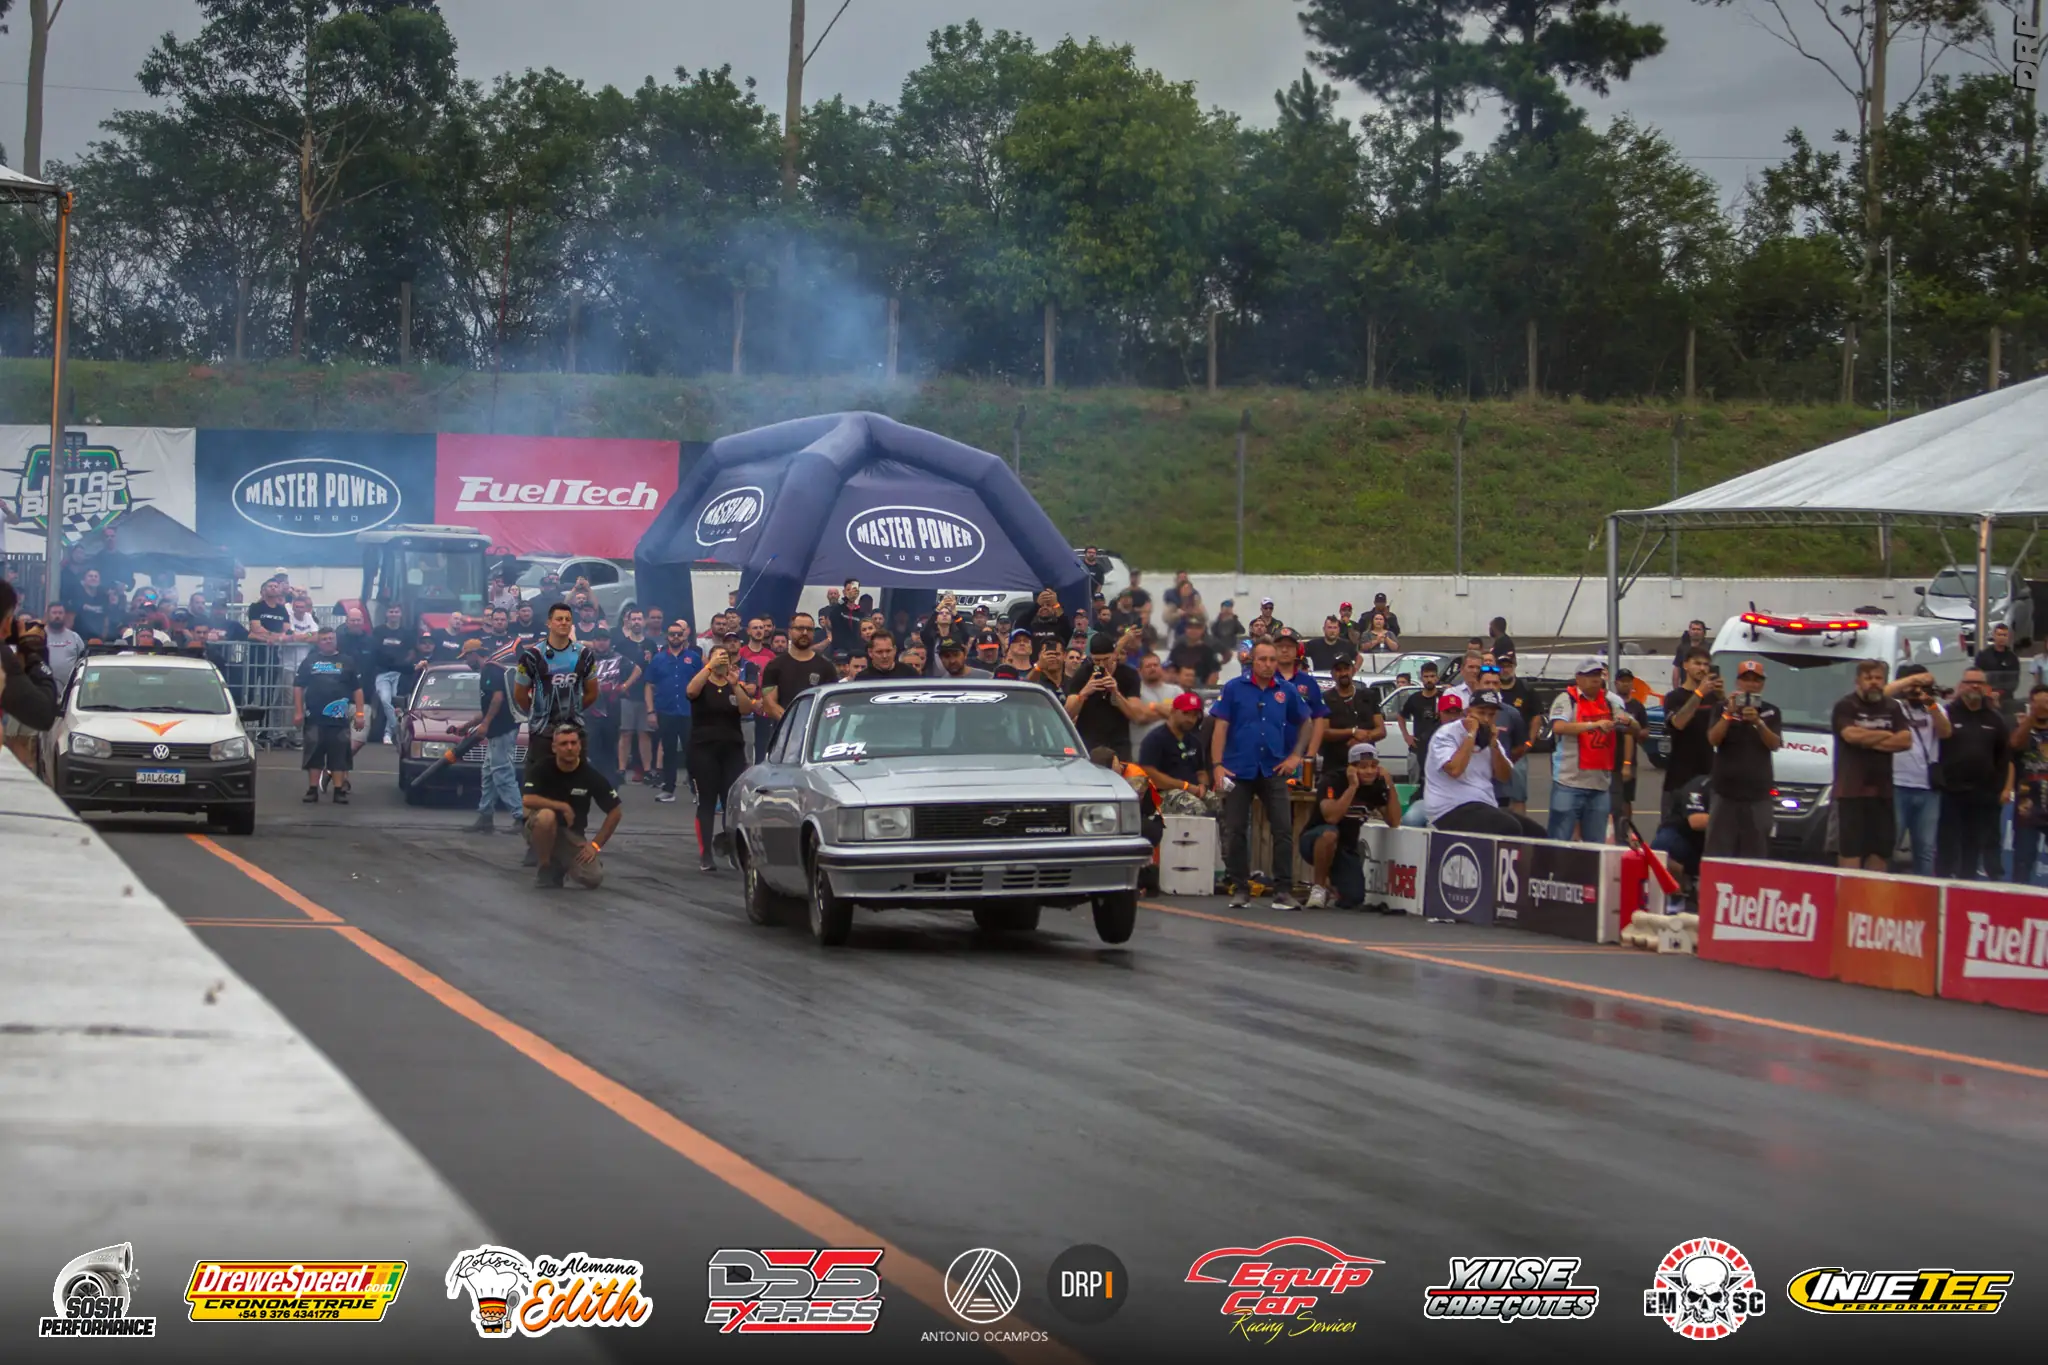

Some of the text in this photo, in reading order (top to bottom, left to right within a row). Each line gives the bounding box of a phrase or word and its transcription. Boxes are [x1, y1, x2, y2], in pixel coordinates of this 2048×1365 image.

[20, 470, 128, 497] LITAS
[246, 472, 388, 508] MASTER POWER
[458, 476, 659, 510] FuelTech
[21, 490, 127, 517] BASIL
[276, 514, 359, 522] TURBO
[857, 517, 973, 549] MASTER POWER
[884, 554, 951, 563] TURBO
[141, 773, 180, 783] JAL6G41
[1025, 826, 1067, 834] CHEVROLET
[1714, 883, 1817, 941] FuelTech
[1847, 911, 1928, 958] VELOPARK
